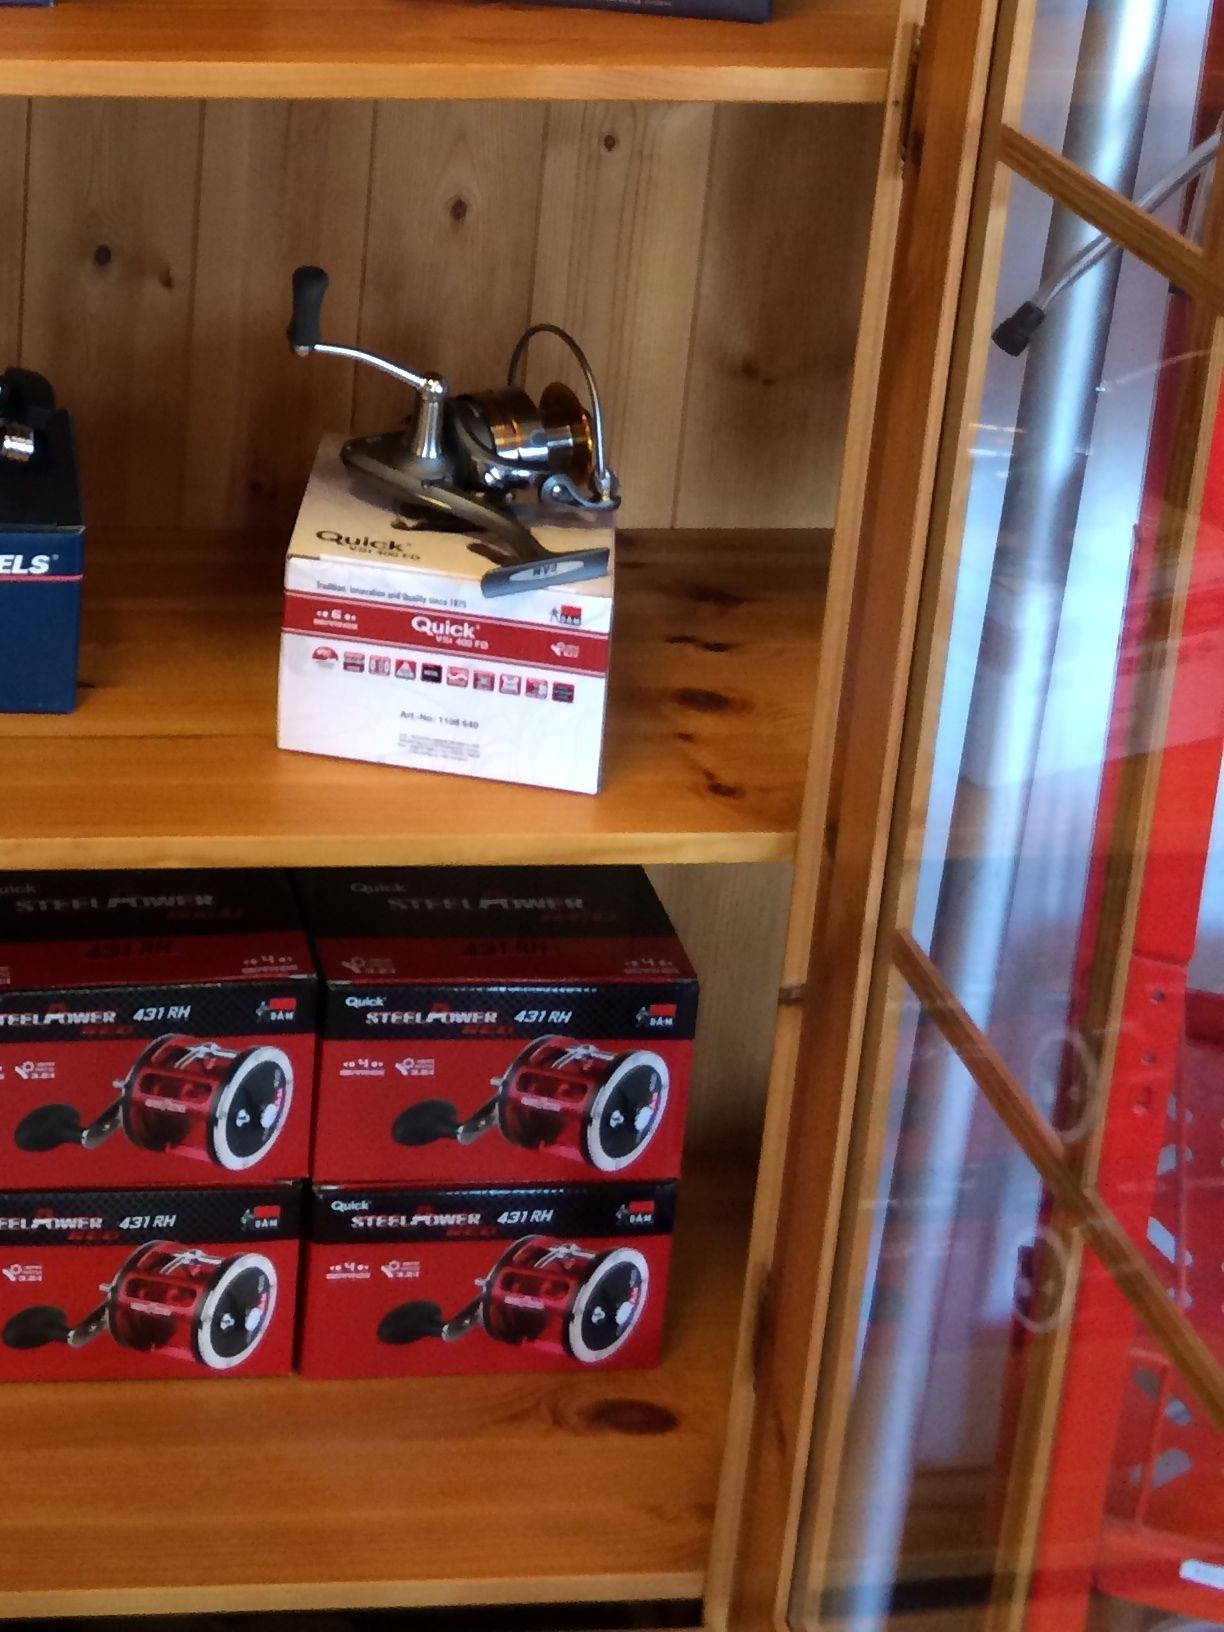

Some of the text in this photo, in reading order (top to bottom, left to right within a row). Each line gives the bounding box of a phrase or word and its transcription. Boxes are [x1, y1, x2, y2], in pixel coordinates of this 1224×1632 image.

[316, 530, 405, 552] Quick
[411, 615, 476, 639] Quick
[345, 996, 384, 1008] Quick
[133, 1007, 164, 1021] 431
[167, 1005, 191, 1019] RH
[514, 1009, 546, 1023] 431
[548, 1010, 572, 1024] RH
[331, 1200, 369, 1212] Quick
[119, 1216, 151, 1230] 431
[154, 1214, 176, 1228] RH
[497, 1211, 529, 1225] 431
[531, 1210, 553, 1223] RH
